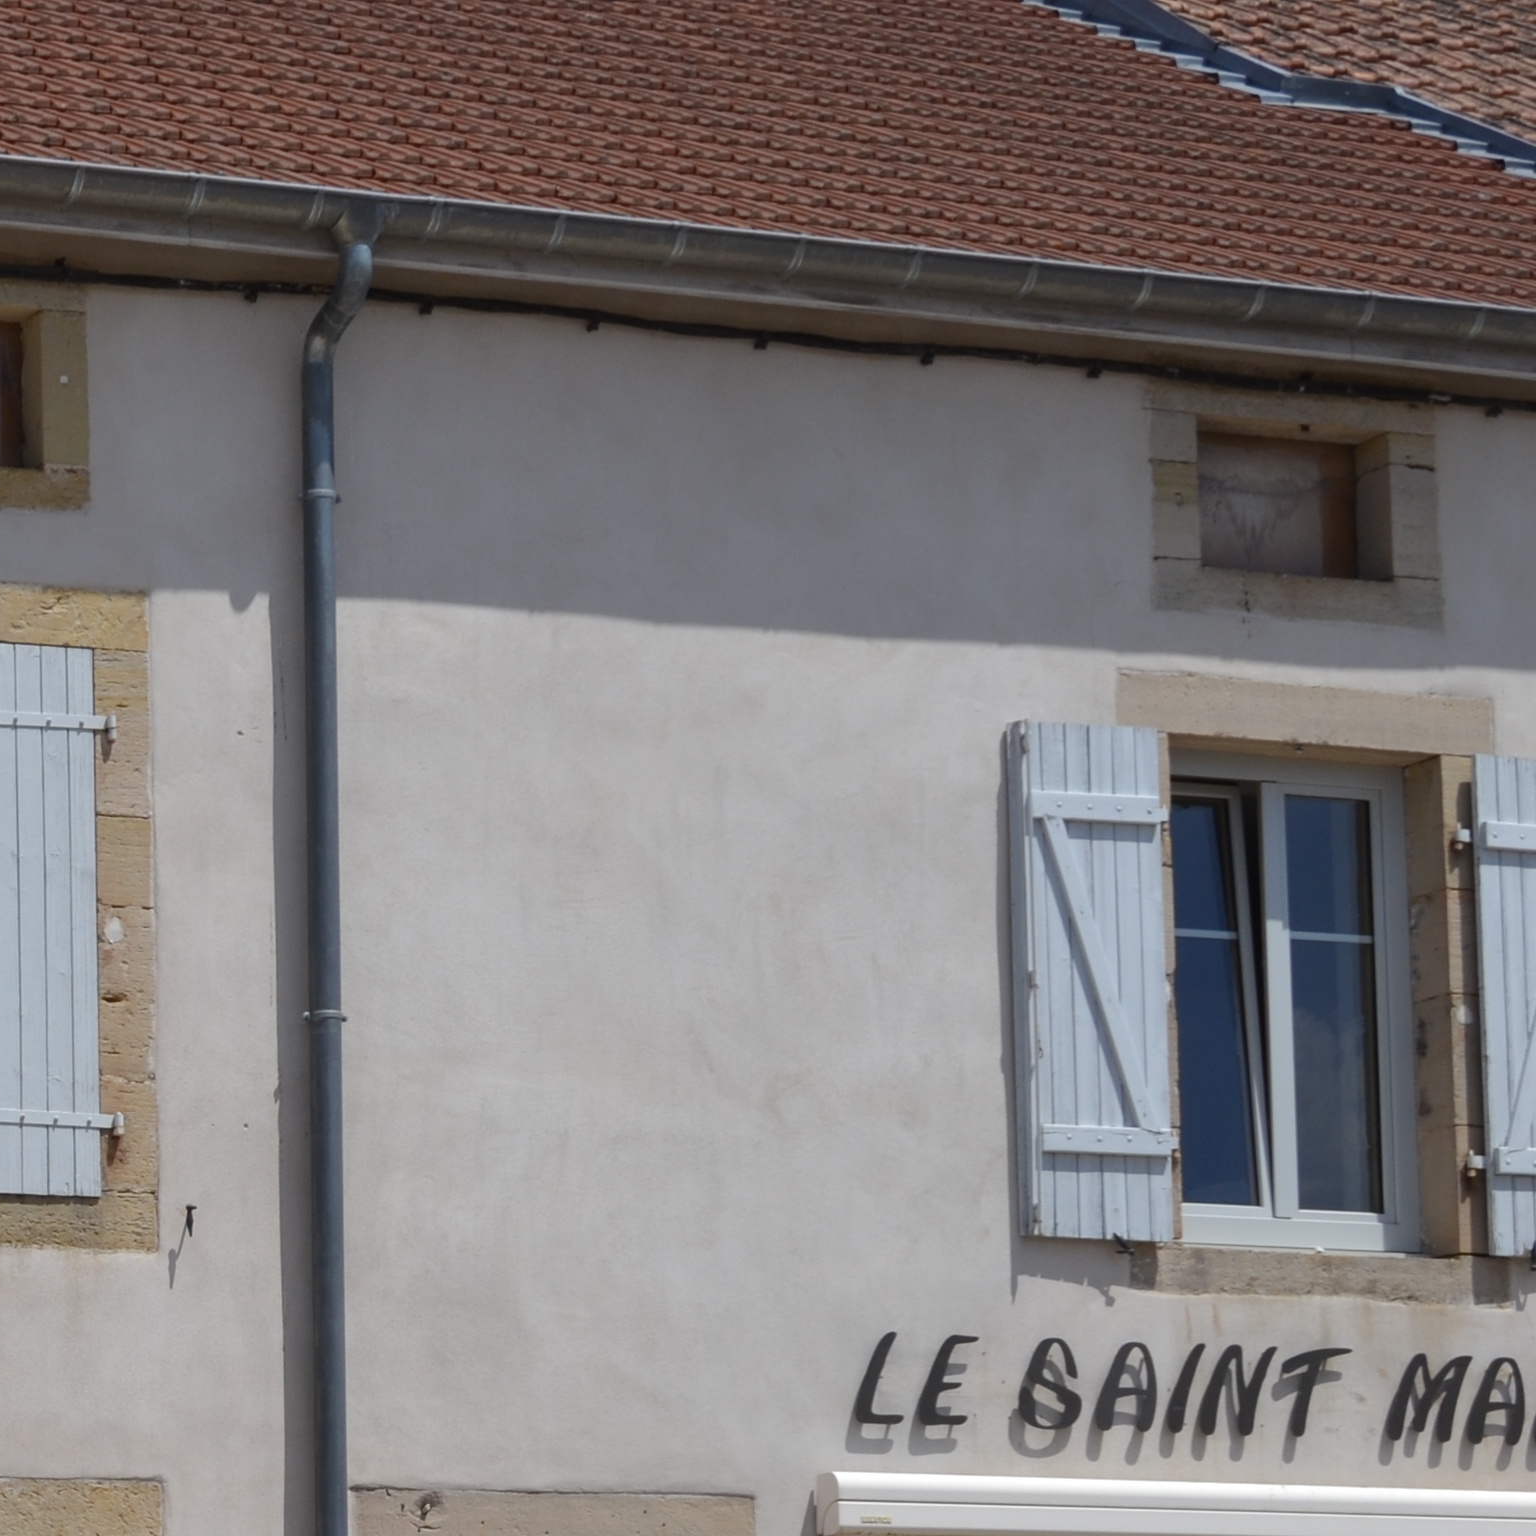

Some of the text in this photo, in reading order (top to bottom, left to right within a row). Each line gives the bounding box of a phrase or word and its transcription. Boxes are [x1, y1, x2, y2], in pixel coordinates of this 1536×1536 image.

[854, 1331, 1536, 1446] LE SAINT MA
